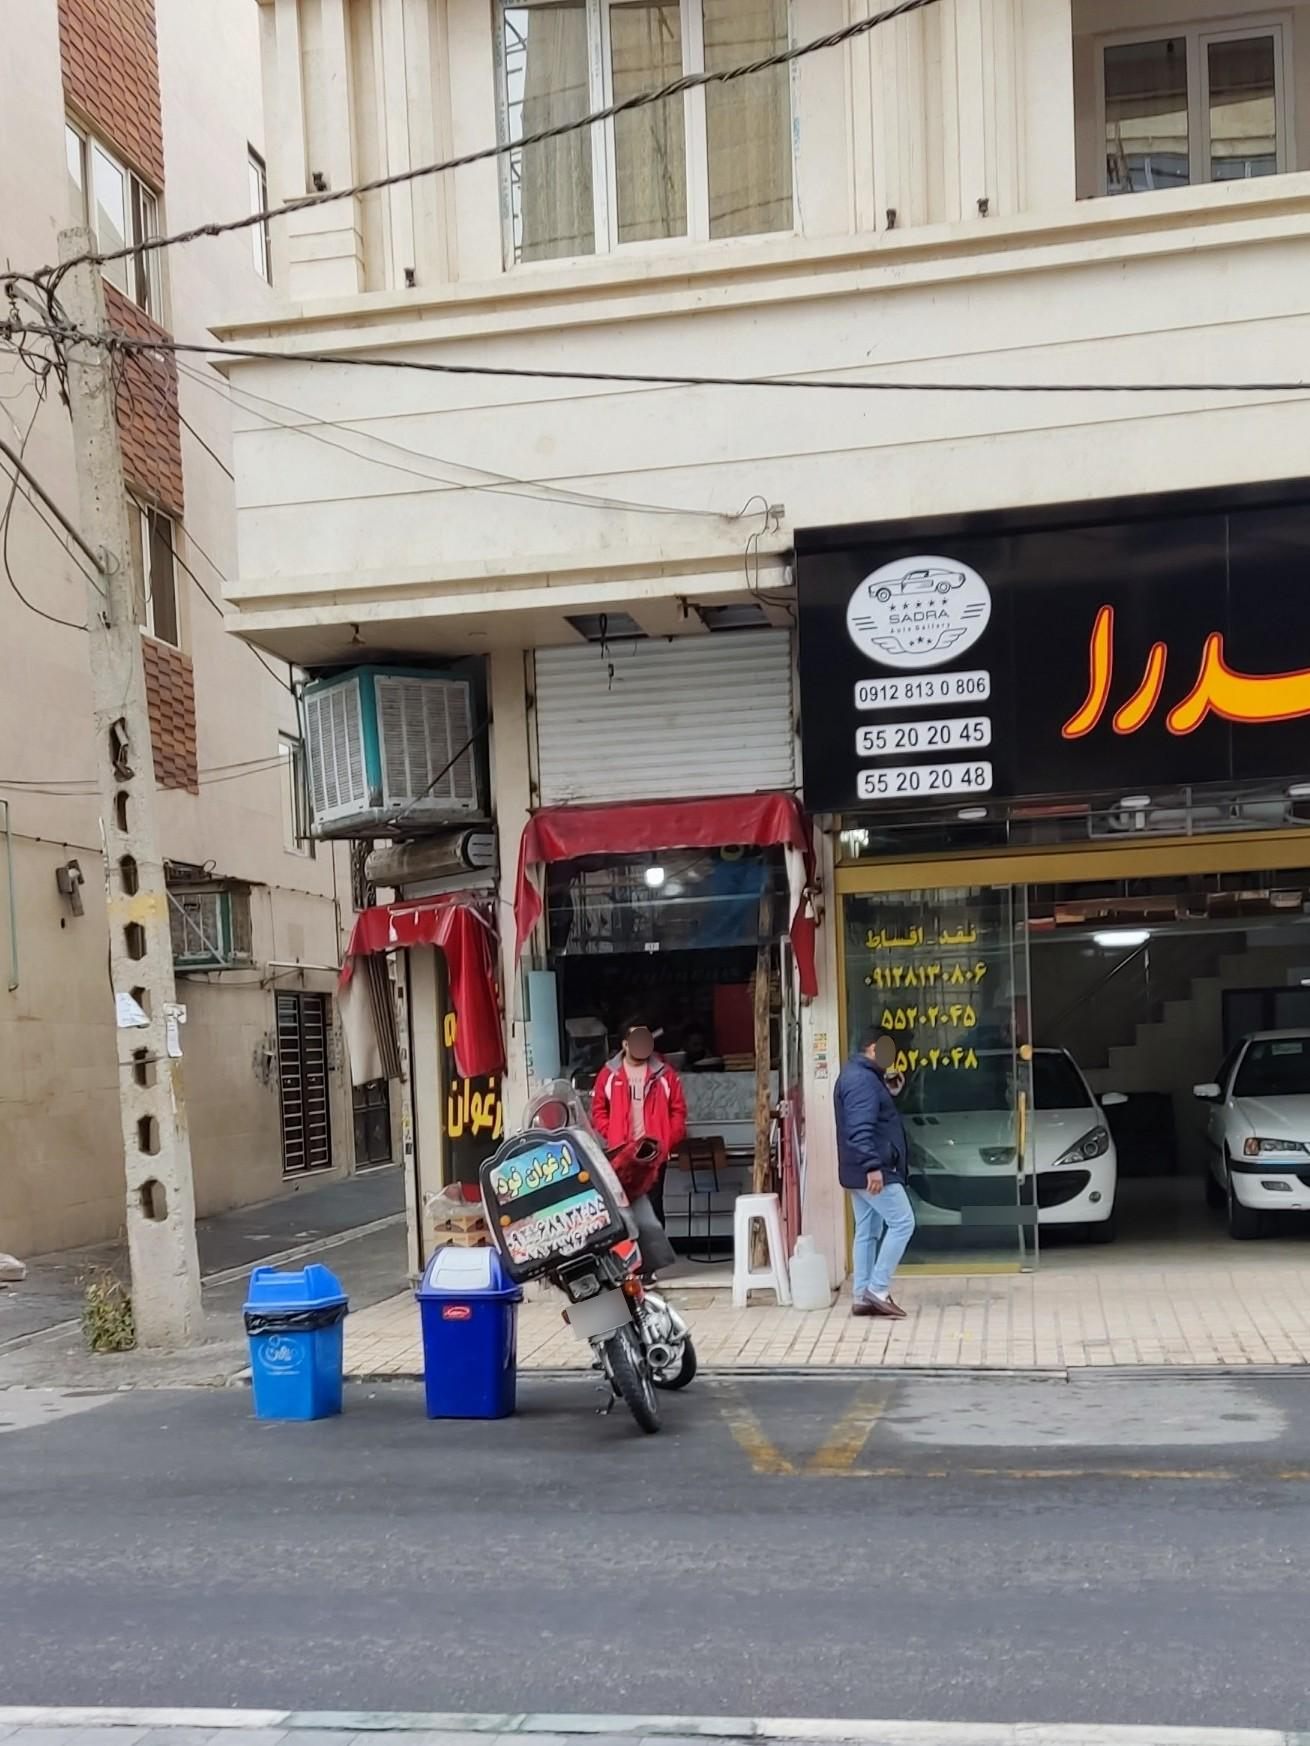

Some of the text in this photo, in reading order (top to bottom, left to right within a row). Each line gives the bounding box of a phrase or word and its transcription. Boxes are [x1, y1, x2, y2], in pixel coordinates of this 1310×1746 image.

[889, 609, 950, 624] SADRA
[1062, 604, 1310, 739] درا
[859, 677, 986, 702] 0912 813 0 806
[863, 722, 984, 750] 55 20 20 45
[864, 766, 985, 794] 55 20 20 48
[865, 925, 925, 949] اقساط
[939, 923, 978, 945] نقد
[881, 1004, 977, 1030] ۵۵۲۰۲۰۴۵
[886, 1046, 979, 1073] ۵۲۰۲۰۴۸
[497, 1144, 573, 1198] ارغوان فود
